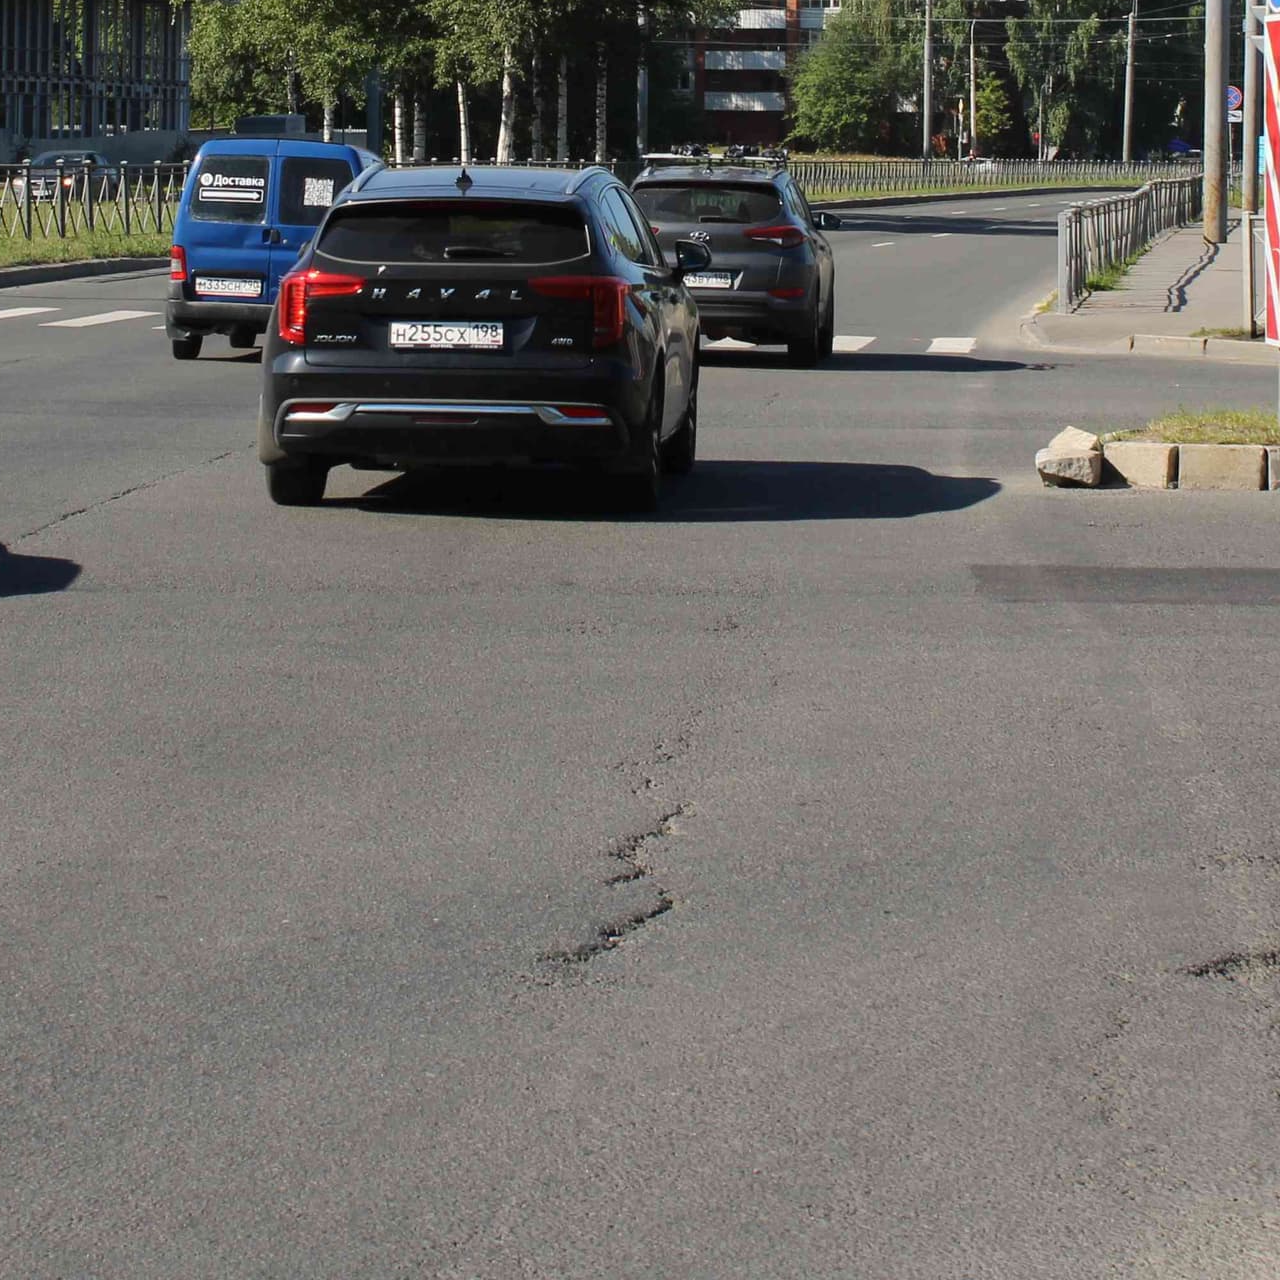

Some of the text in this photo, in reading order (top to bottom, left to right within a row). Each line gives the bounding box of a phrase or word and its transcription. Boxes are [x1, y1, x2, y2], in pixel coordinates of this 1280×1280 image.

[213, 174, 265, 187] Доставка
[372, 287, 522, 301] HAVAL
[313, 334, 357, 343] JOLION
